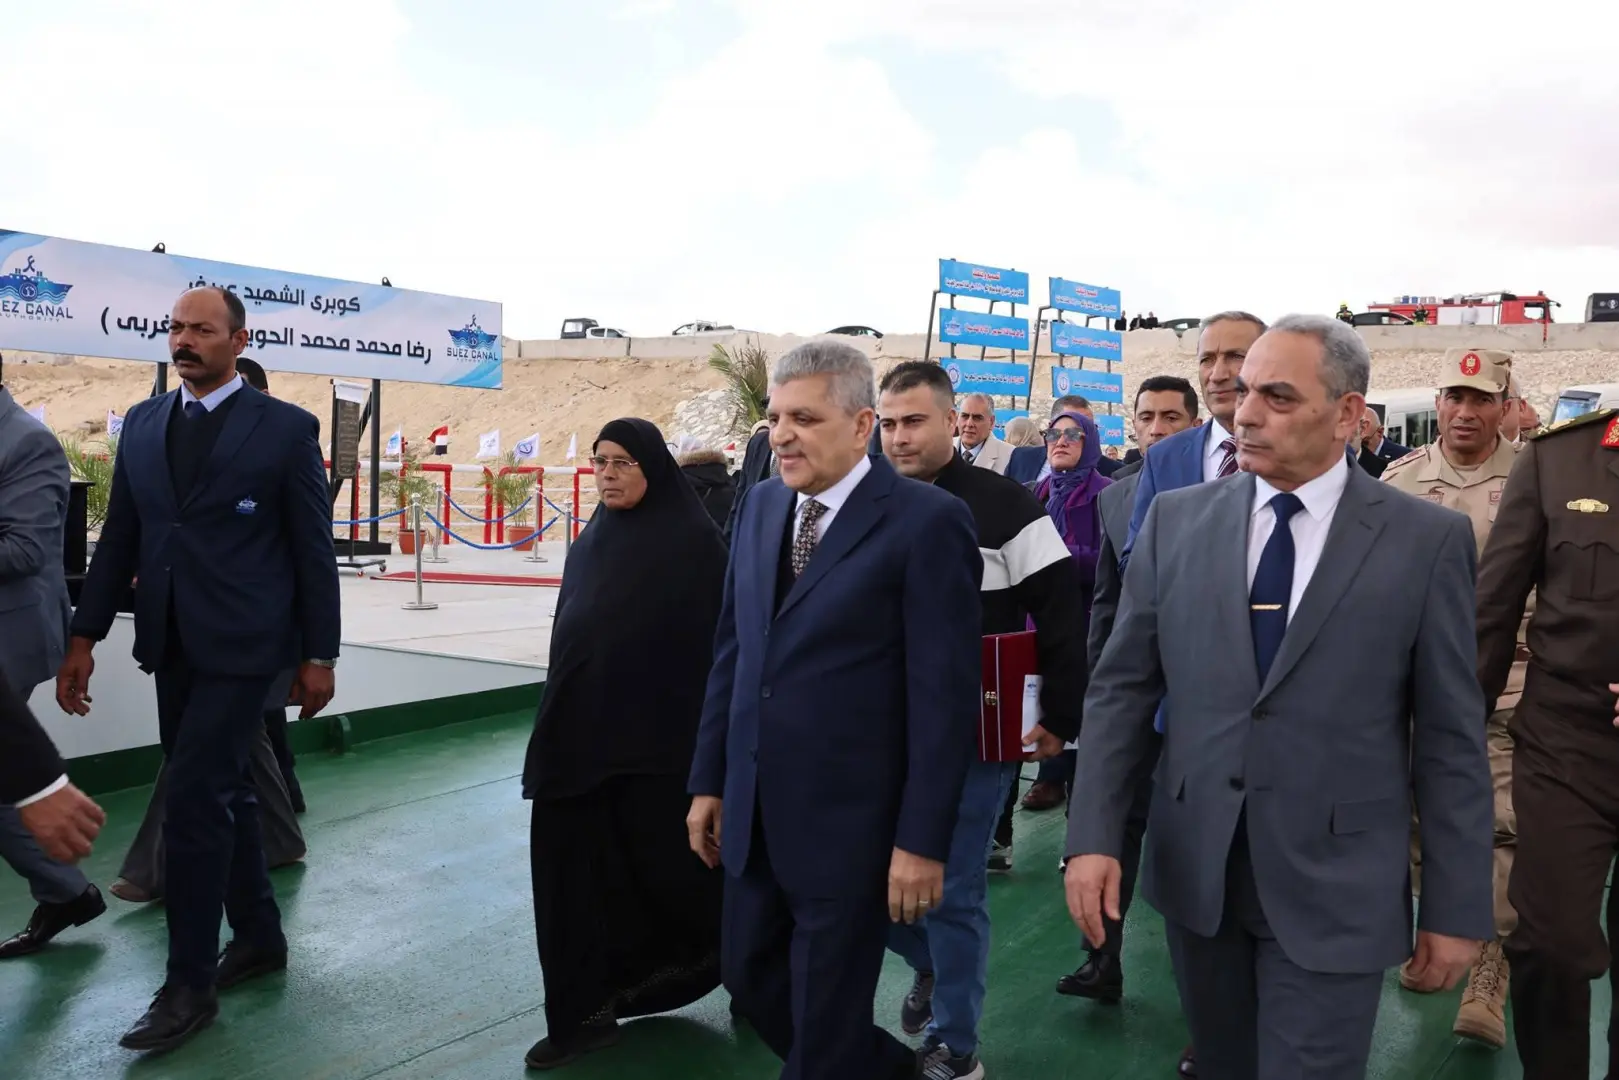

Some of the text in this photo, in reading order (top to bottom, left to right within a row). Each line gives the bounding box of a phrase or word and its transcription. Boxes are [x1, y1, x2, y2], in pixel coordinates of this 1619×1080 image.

[243, 284, 305, 306] الشهيد
[310, 294, 361, 316] كوبرى
[1, 300, 74, 319] EZ CANAL
[247, 326, 294, 349] الحوي
[300, 333, 350, 351] محمد
[355, 339, 402, 357] محمد
[407, 339, 432, 365] رضا
[446, 347, 469, 358] SUEZ
[471, 349, 499, 361] CANAL
